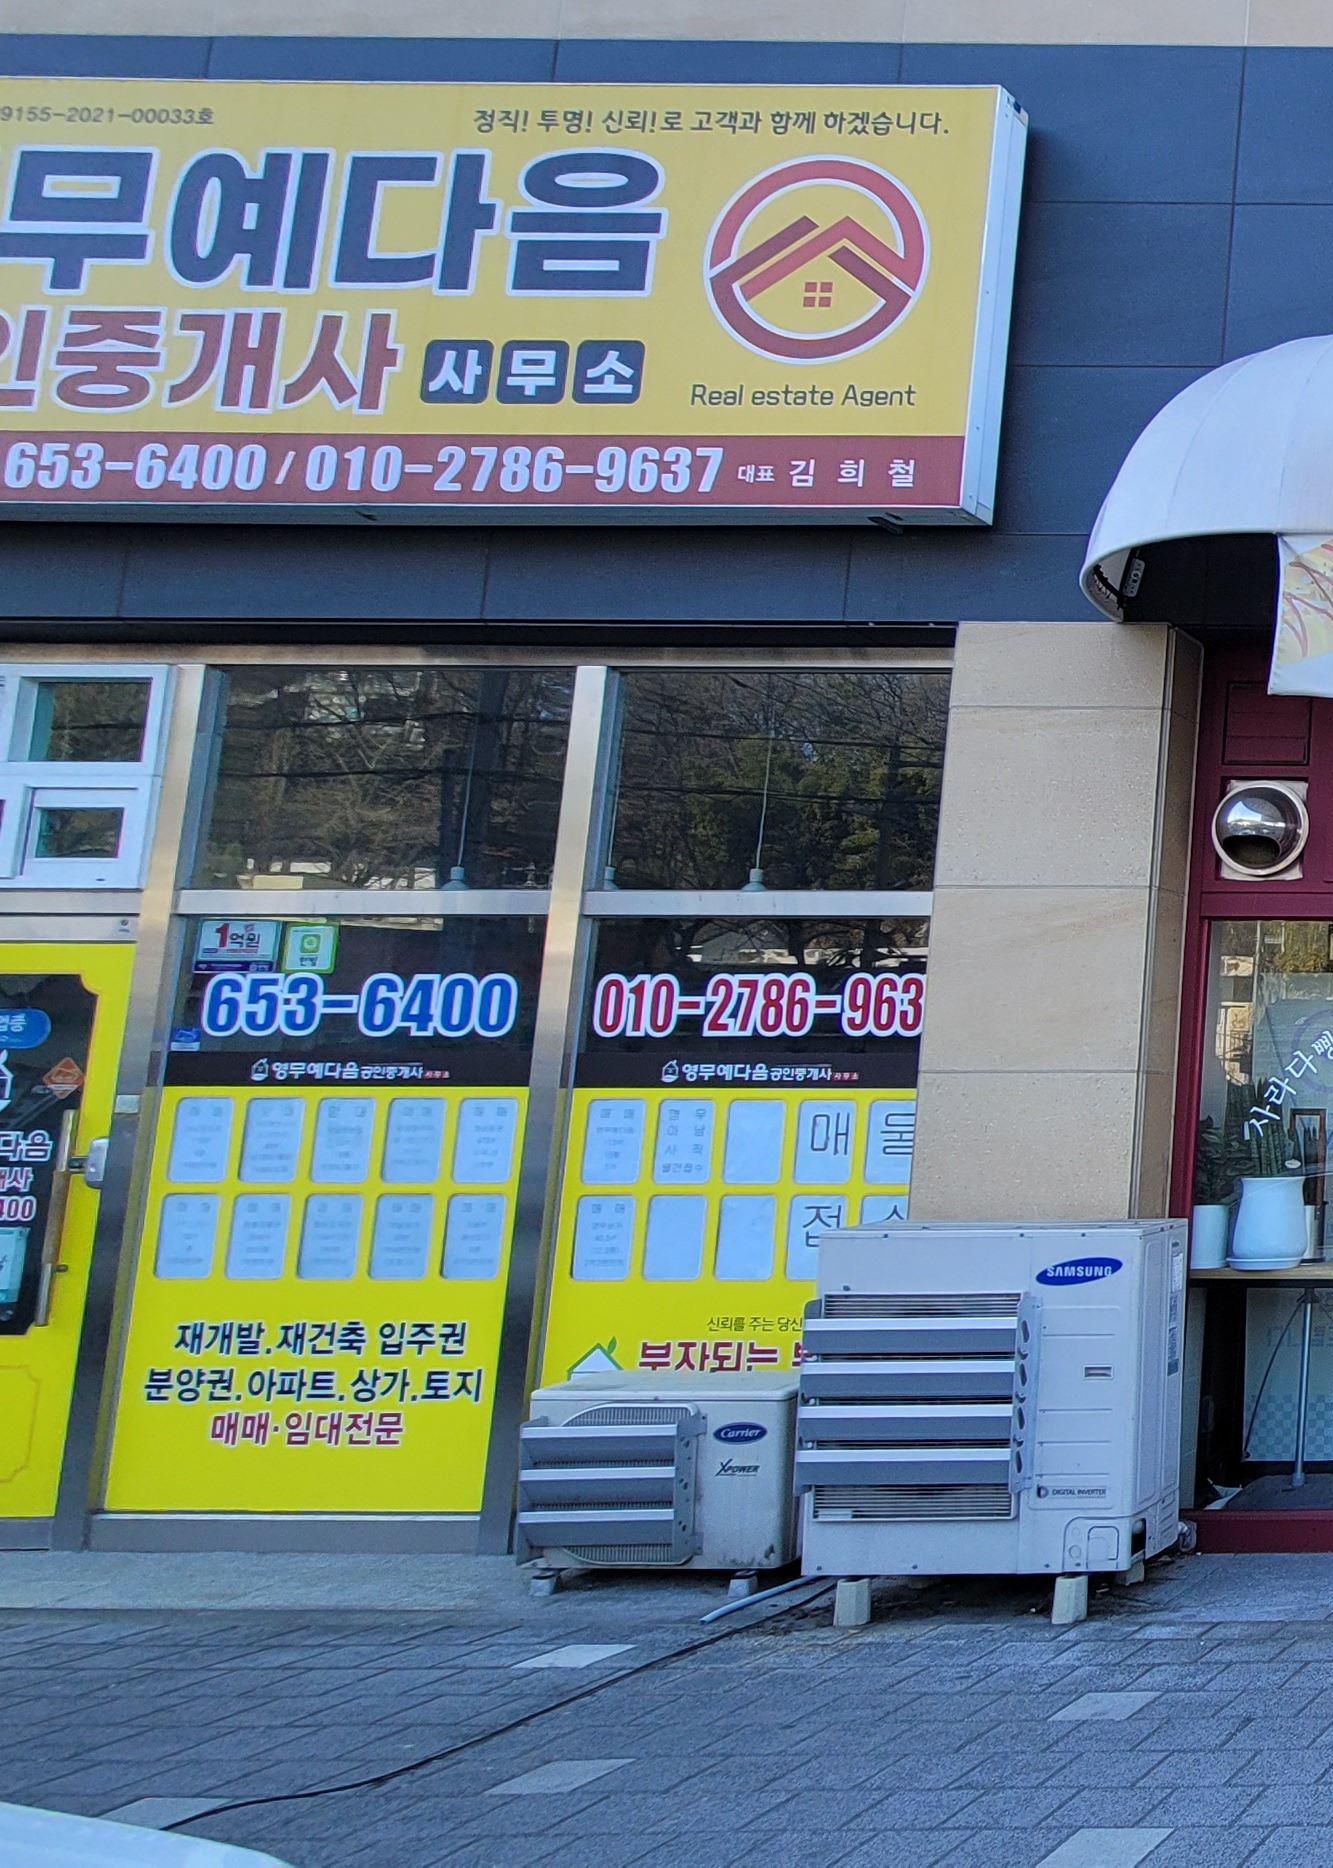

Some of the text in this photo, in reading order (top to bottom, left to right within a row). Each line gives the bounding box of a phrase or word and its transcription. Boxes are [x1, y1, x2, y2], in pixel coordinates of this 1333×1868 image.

[473, 109, 951, 136] 정직! 투명! 신뢰!로 고객과 함께 하겠습니다.
[428, 346, 636, 398] 사무소
[690, 383, 917, 409] Real estate Agent
[3, 441, 268, 491] 653-6400
[304, 443, 724, 494] 010-2786-9637
[737, 462, 775, 484] 대표
[201, 972, 518, 1038] 653-6400
[594, 972, 924, 1038] 010-2786-963
[271, 1061, 360, 1080] 영무예다음
[681, 1062, 769, 1082] 영무예다음
[1046, 1264, 1113, 1278] SAMSUNG
[706, 1316, 746, 1333] 신뢰를
[748, 1316, 775, 1332] 주는
[378, 1321, 467, 1357] 입주권
[720, 1427, 761, 1440] Carrier
[1051, 1488, 1107, 1497] DIGITAL INVERTER
